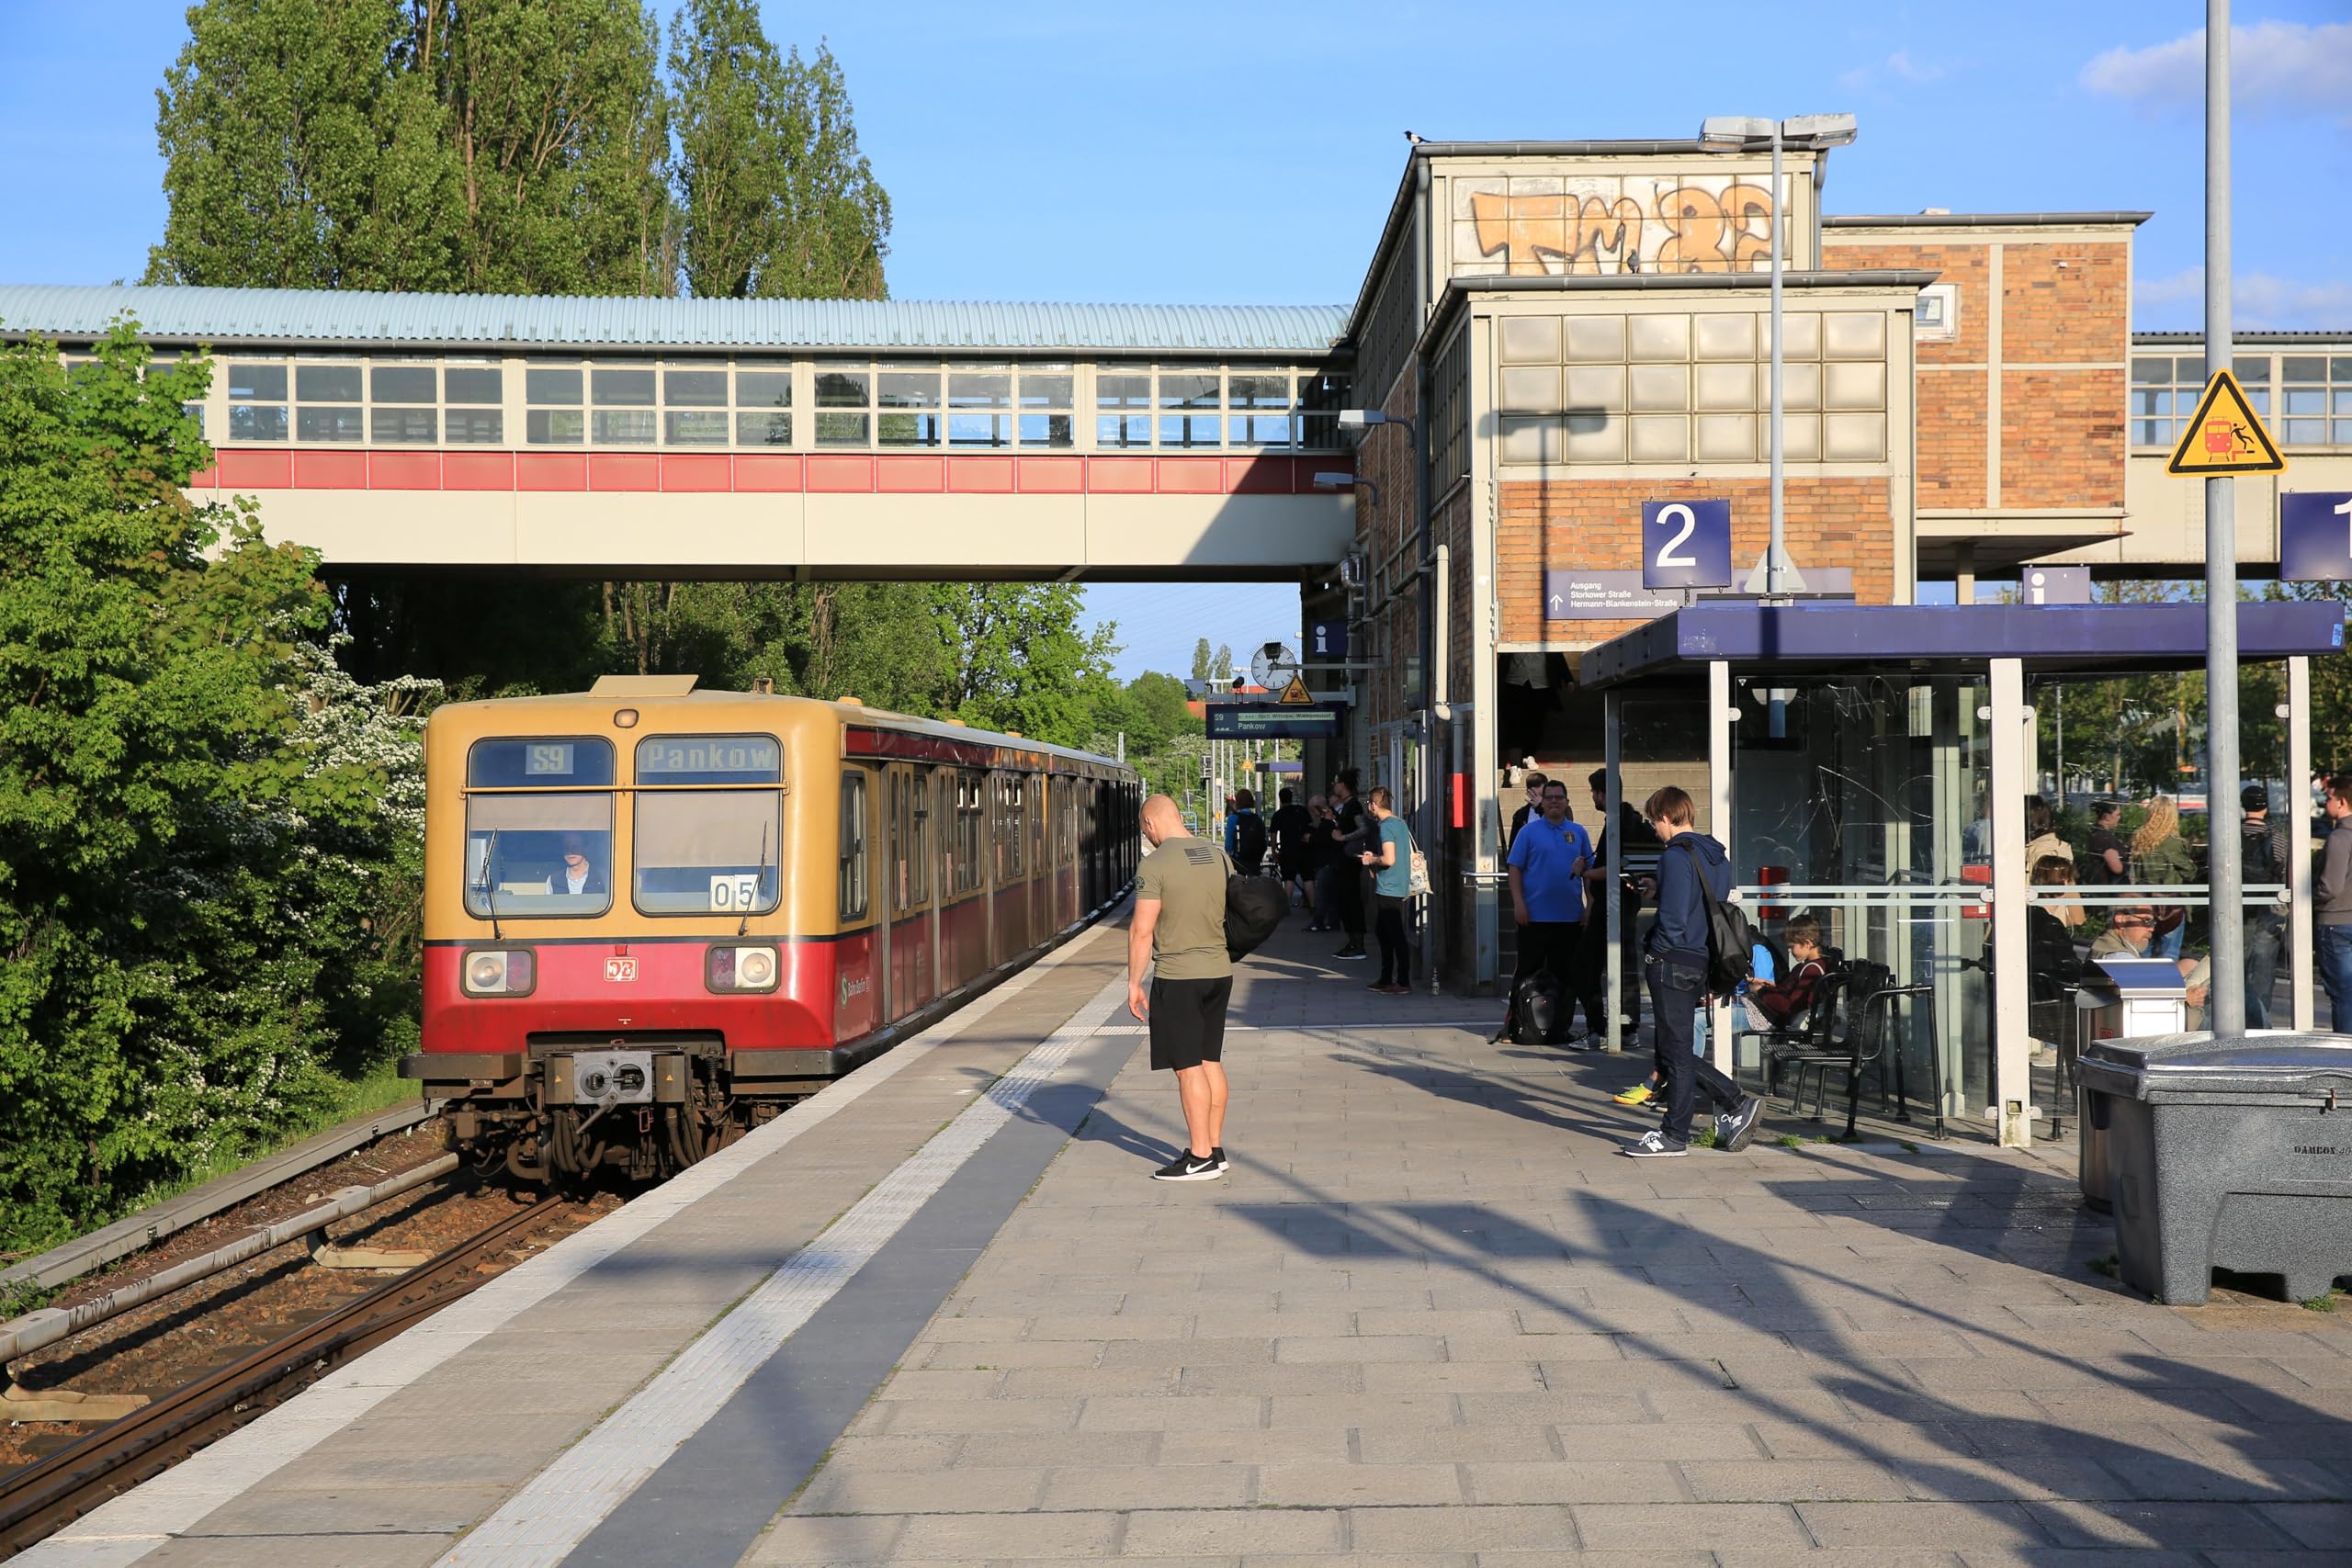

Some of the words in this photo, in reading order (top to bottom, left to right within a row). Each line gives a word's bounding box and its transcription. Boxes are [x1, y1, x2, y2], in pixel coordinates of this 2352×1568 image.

[1655, 503, 1696, 567] 2
[1570, 581, 1601, 591] Ausgang
[1570, 591, 1606, 599] Storkower
[1608, 591, 1632, 599] Straße
[1570, 599, 1678, 608] Hermann-Blankenstein-Straße
[1238, 722, 1266, 730] Pankow
[533, 745, 565, 772] S9
[648, 742, 774, 770] Pankow
[608, 961, 633, 977] DB
